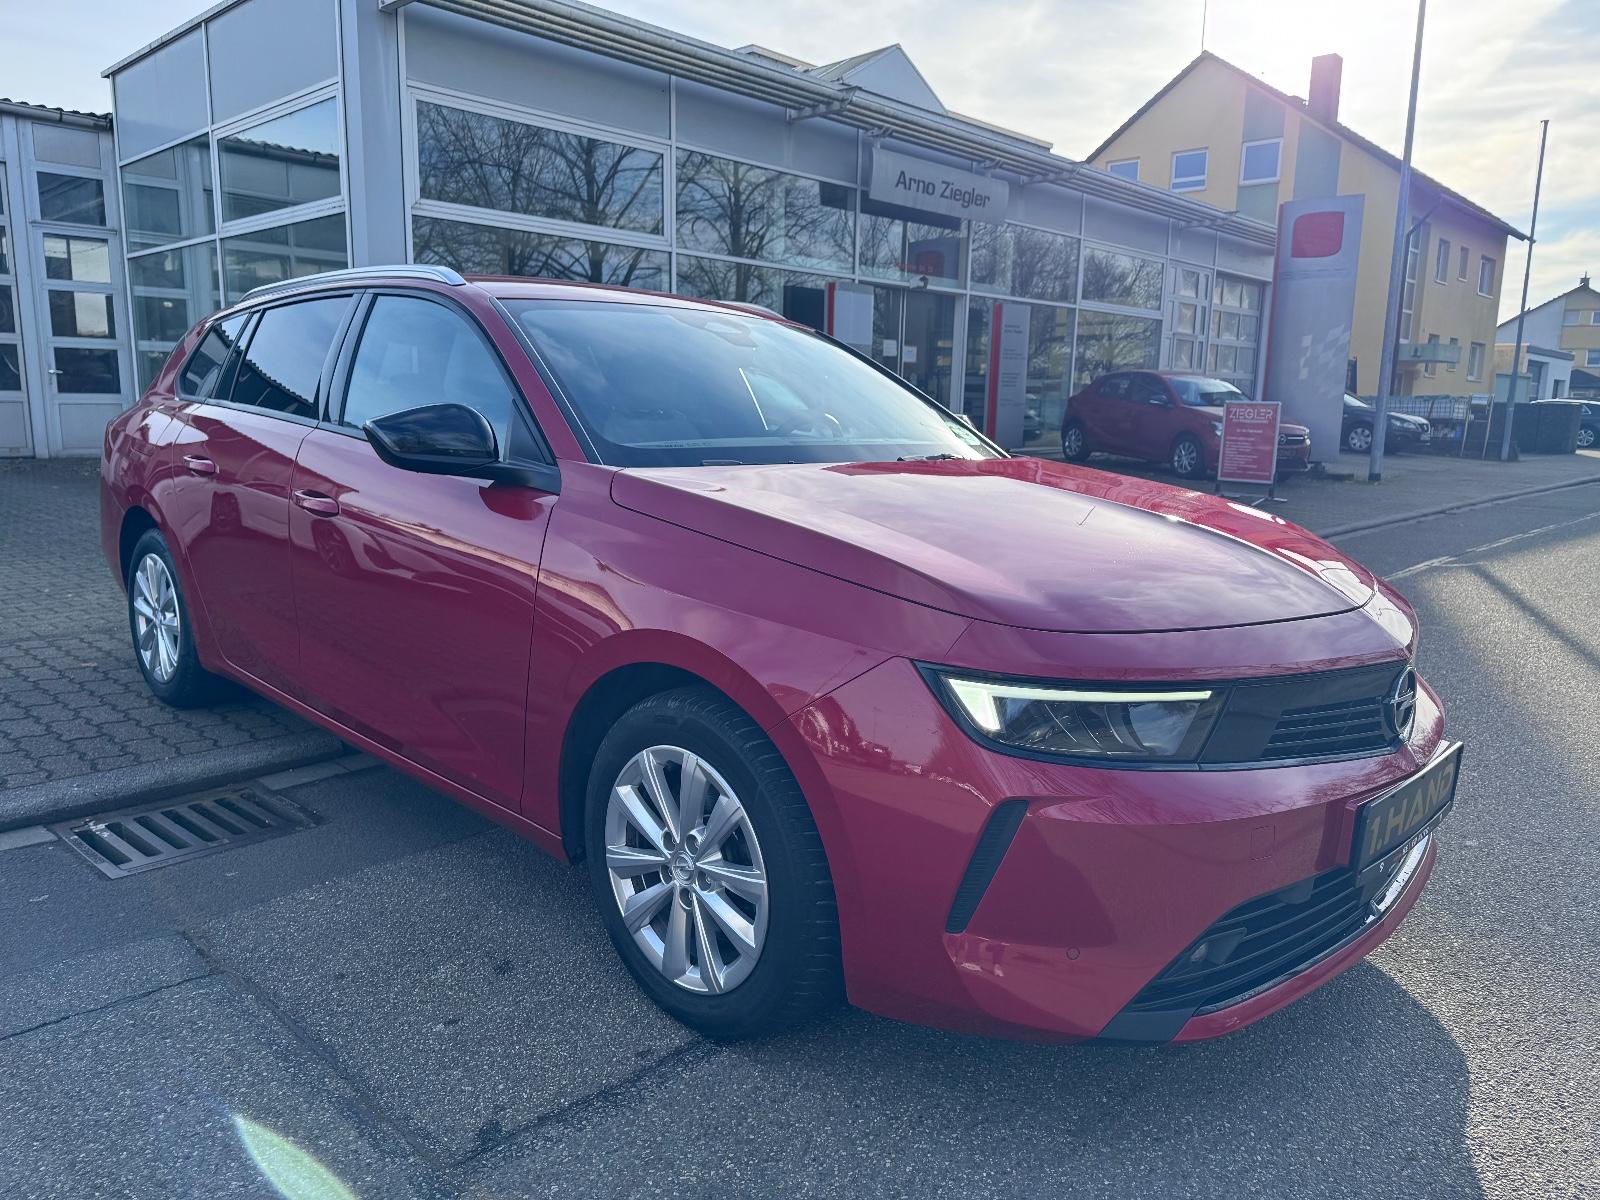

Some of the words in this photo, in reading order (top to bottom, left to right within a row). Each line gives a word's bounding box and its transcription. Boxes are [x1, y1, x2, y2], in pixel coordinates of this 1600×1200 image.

[895, 170, 936, 196] Arno
[940, 180, 991, 208] Ziegler
[1229, 408, 1273, 420] ZIEGLER
